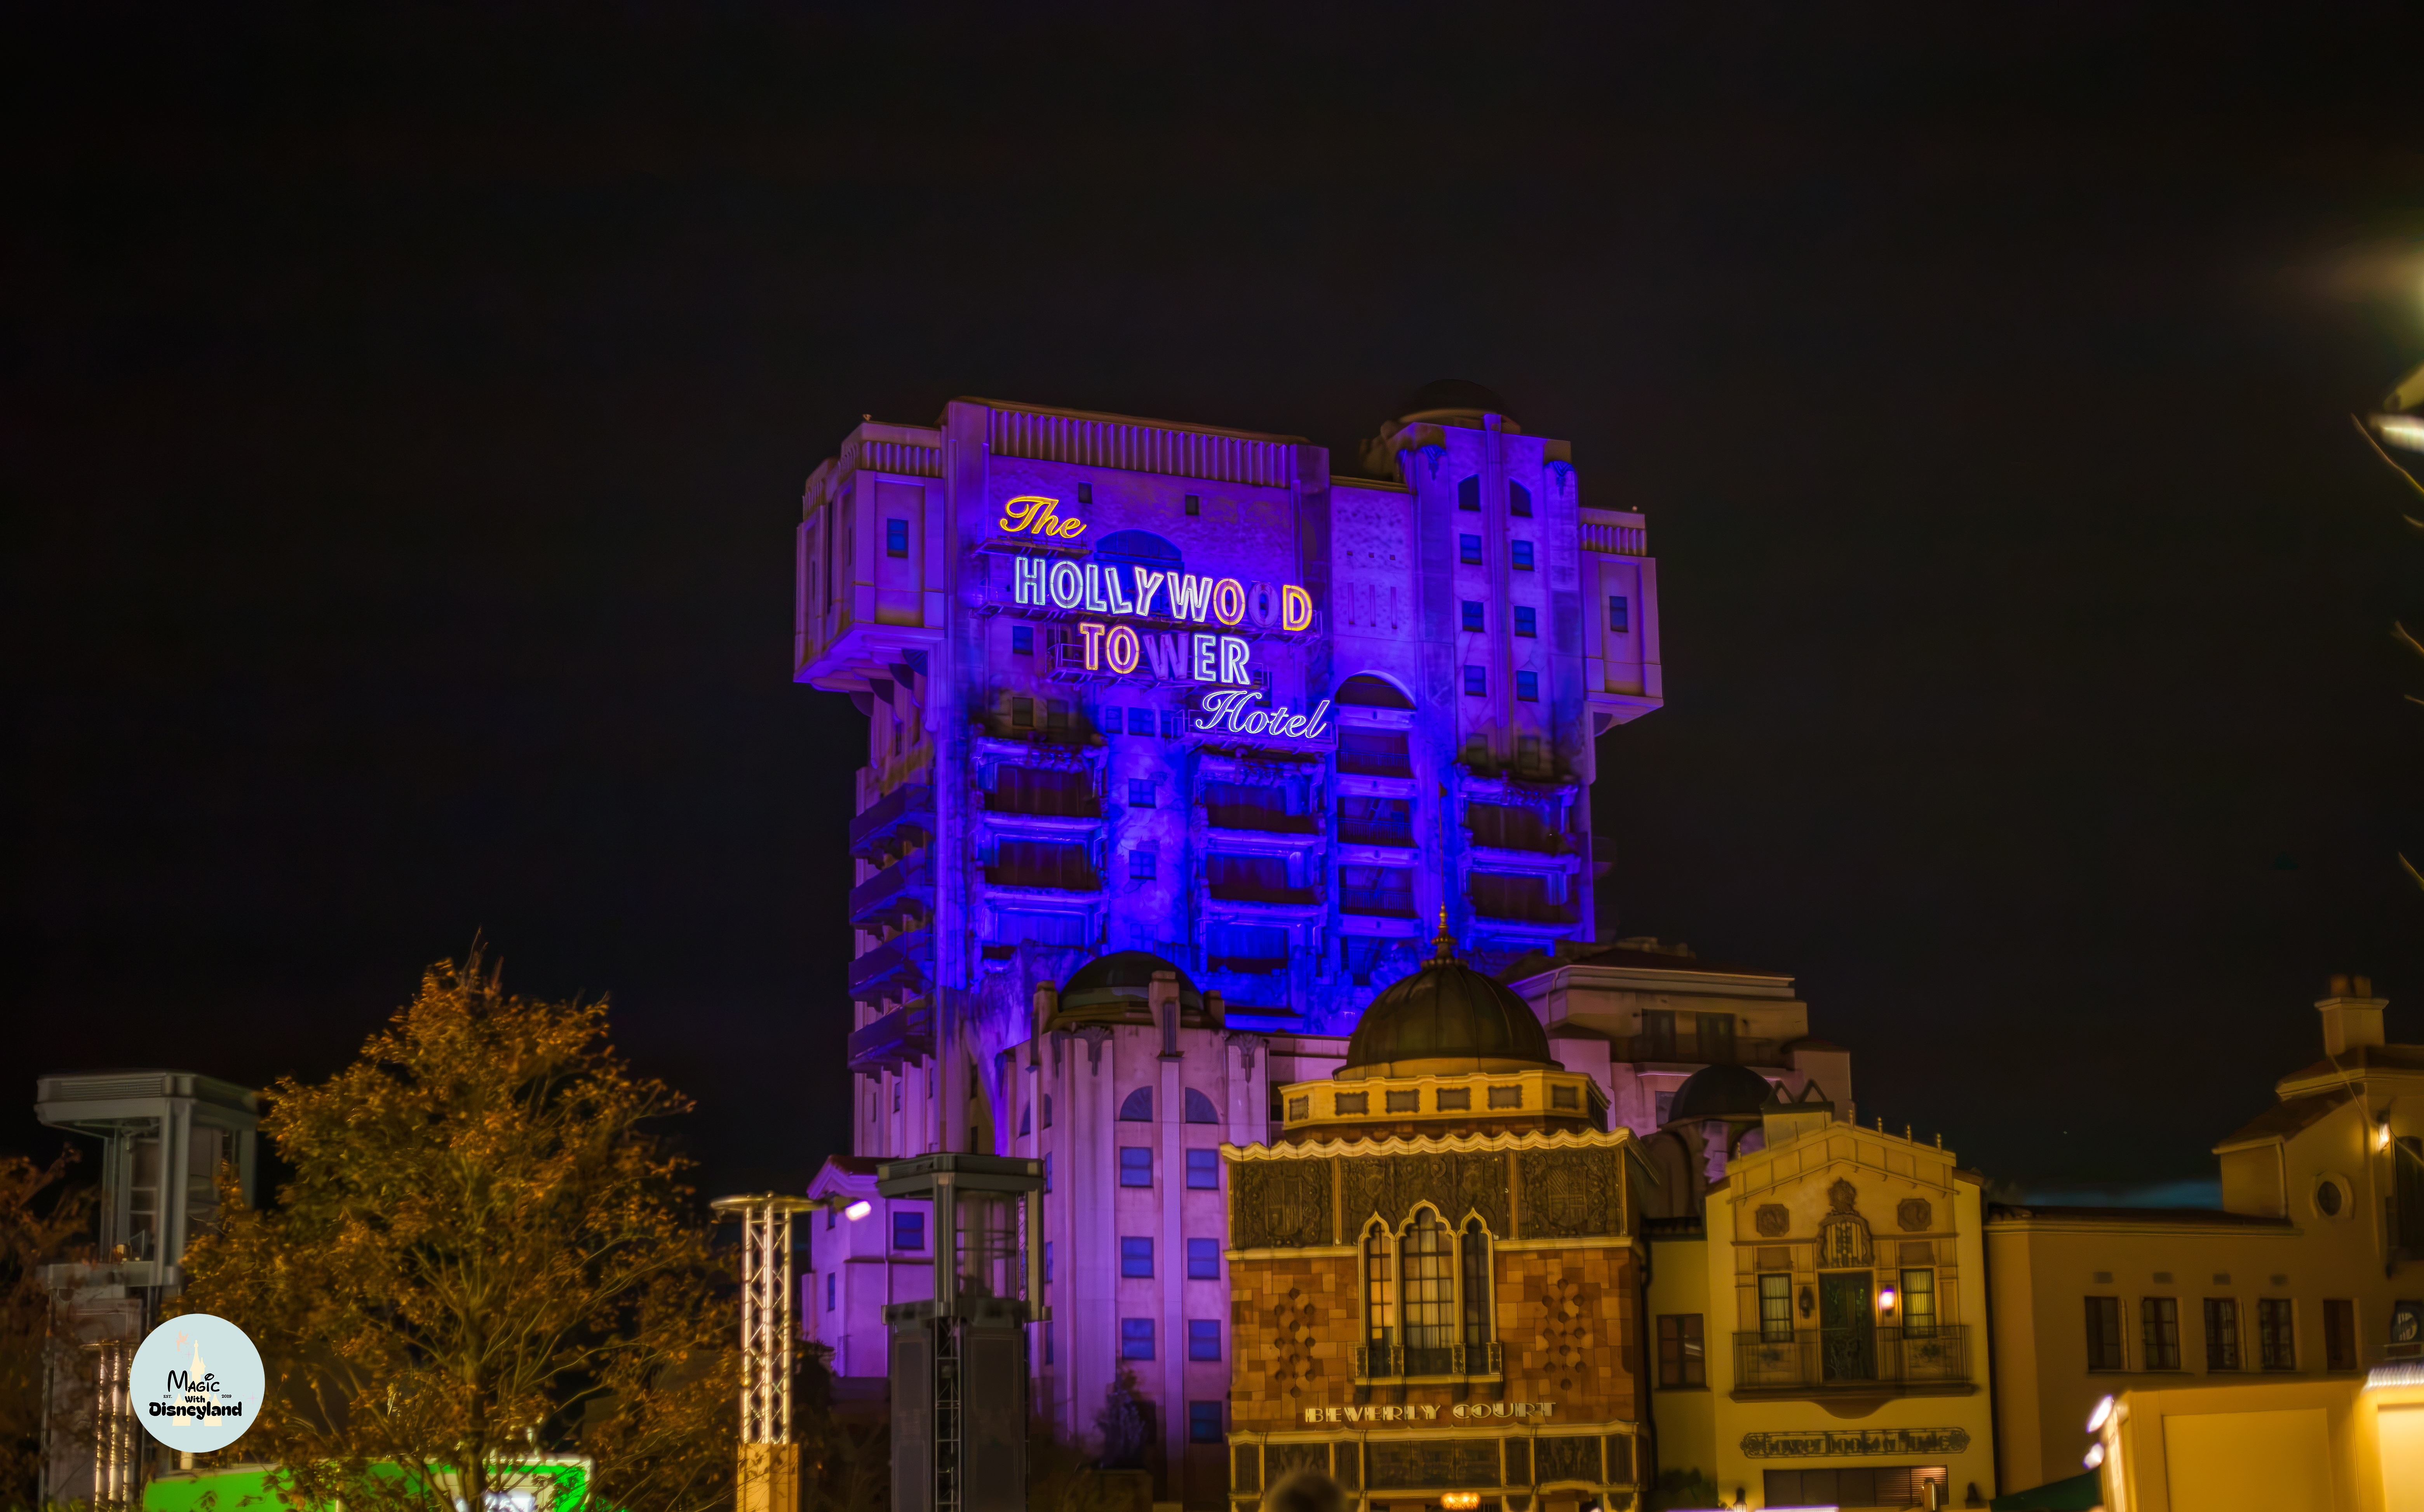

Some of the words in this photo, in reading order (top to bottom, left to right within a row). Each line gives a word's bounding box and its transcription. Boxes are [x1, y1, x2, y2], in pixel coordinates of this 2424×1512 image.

[1000, 495, 1087, 539] The
[1014, 556, 1313, 632] HOLLYWOOD
[1079, 623, 1251, 685] TOWER
[1195, 689, 1330, 739] Hotel
[1305, 1403, 1441, 1422] BEVERLY
[1452, 1402, 1557, 1419] COURT
